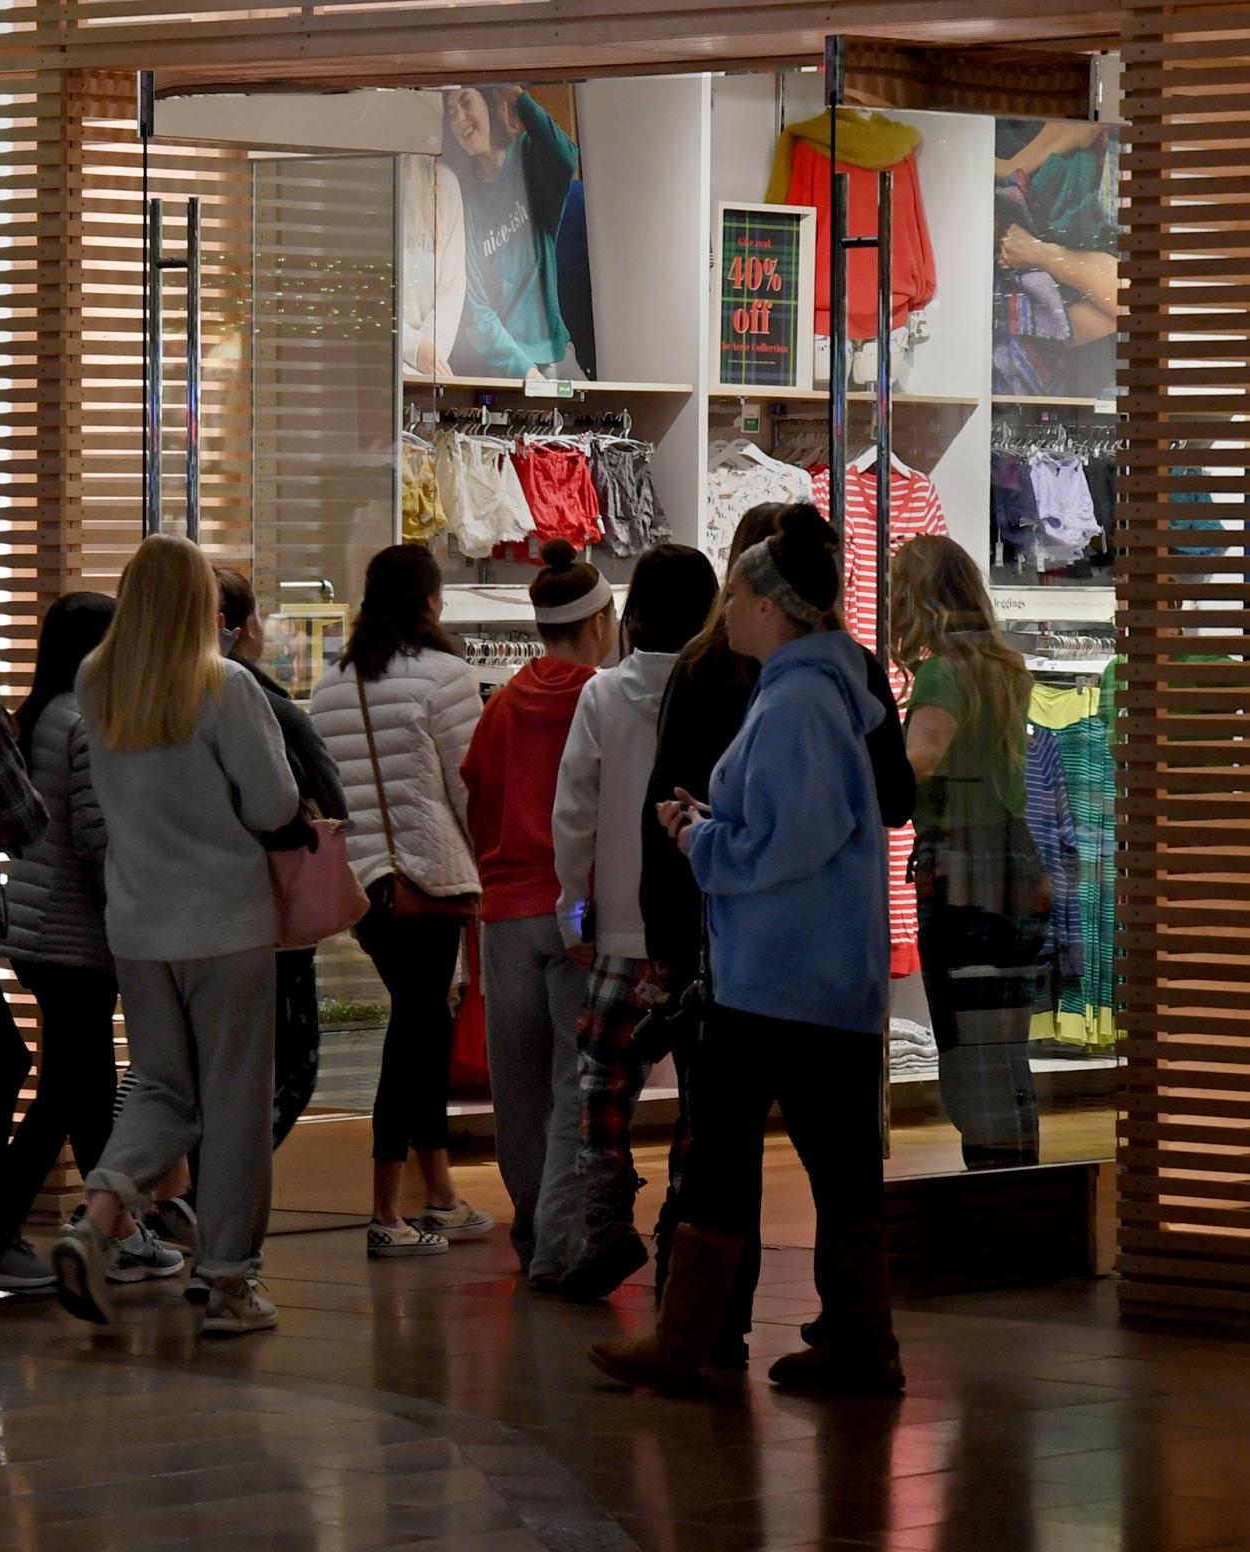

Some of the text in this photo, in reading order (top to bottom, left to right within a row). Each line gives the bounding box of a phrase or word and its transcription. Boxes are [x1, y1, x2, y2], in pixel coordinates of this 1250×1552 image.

[482, 200, 529, 257] nice-ish
[727, 255, 783, 292] 40%
[732, 298, 773, 335] off
[993, 597, 1026, 610] leggings
